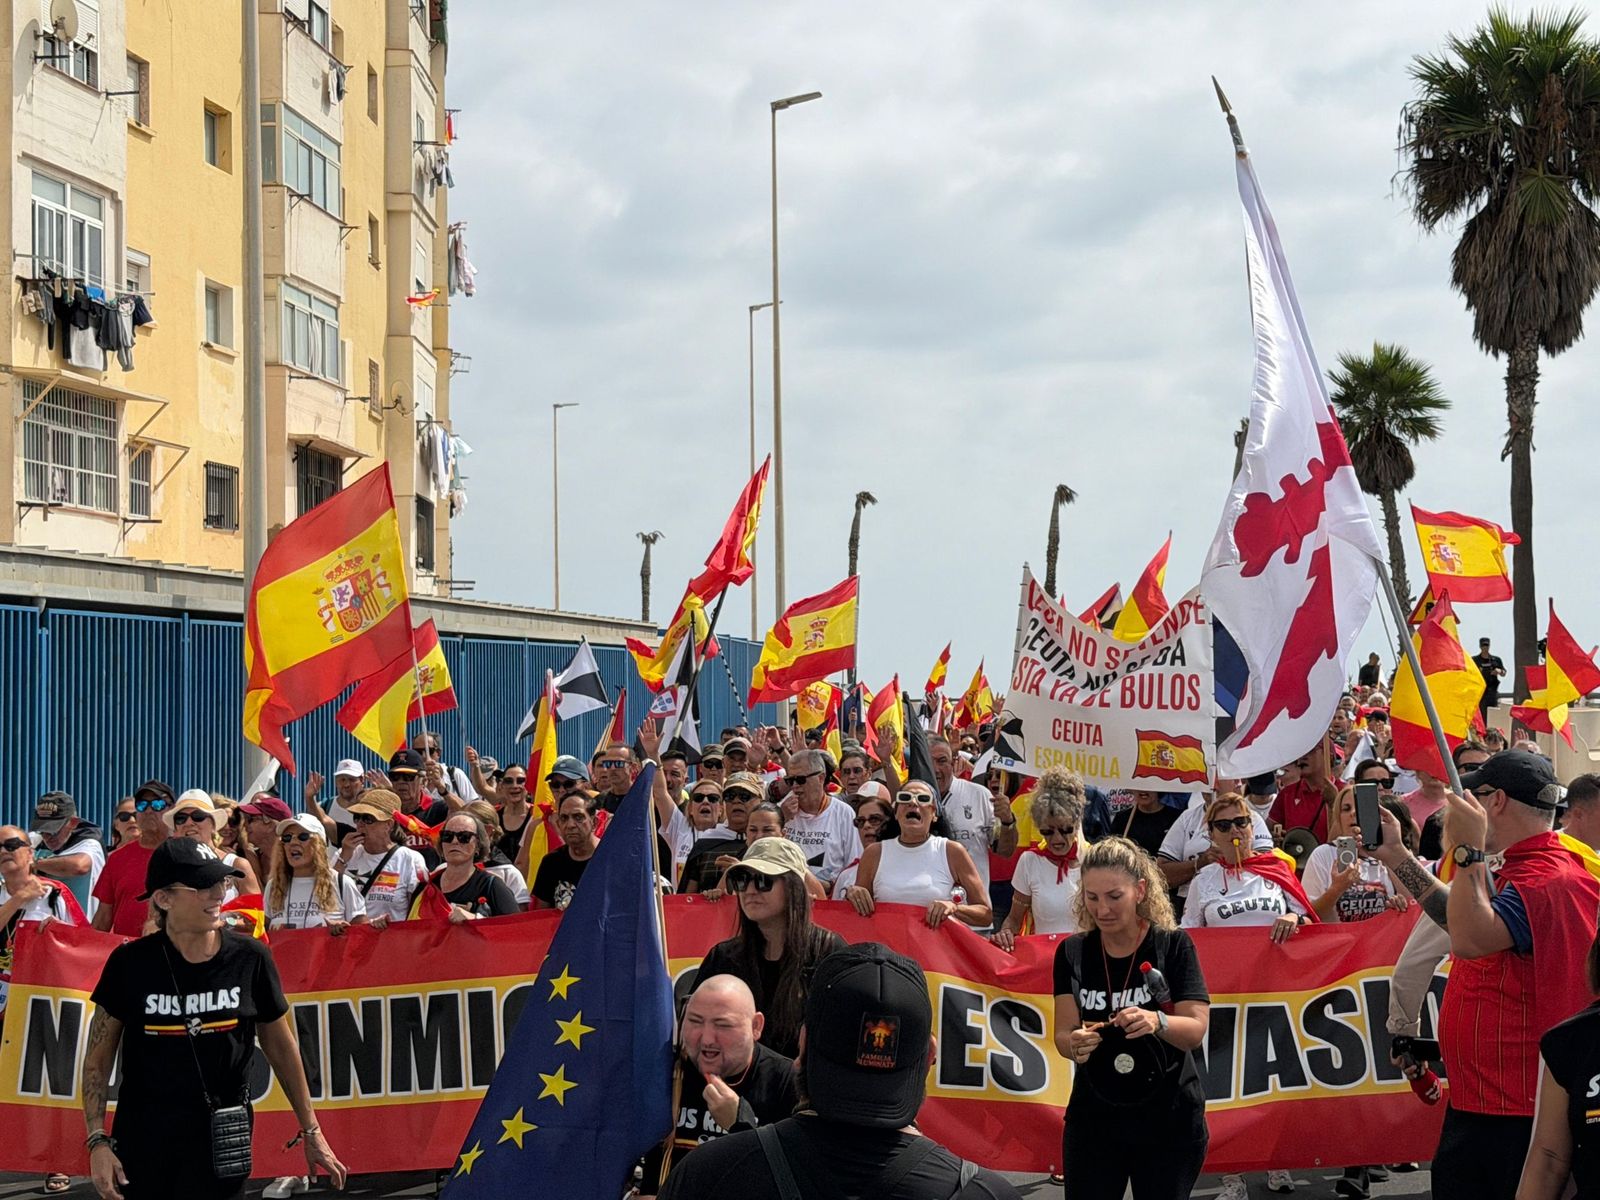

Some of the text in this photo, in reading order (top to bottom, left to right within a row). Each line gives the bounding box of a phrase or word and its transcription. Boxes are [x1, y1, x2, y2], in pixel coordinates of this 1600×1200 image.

[1021, 617, 1076, 681] CEUTA
[1151, 636, 1186, 667] DA
[1068, 626, 1098, 668] NO
[1049, 679, 1080, 704] YA
[1120, 673, 1201, 711] BULOS
[1051, 718, 1104, 746] CEUTA
[1034, 745, 1121, 780] ESPAÑOLA
[1217, 897, 1282, 920] CEUTA
[1340, 898, 1385, 912] CEUTA
[145, 986, 241, 1016] SUS RILAS
[1080, 988, 1107, 1011] SUS
[934, 982, 1051, 1096] ES
